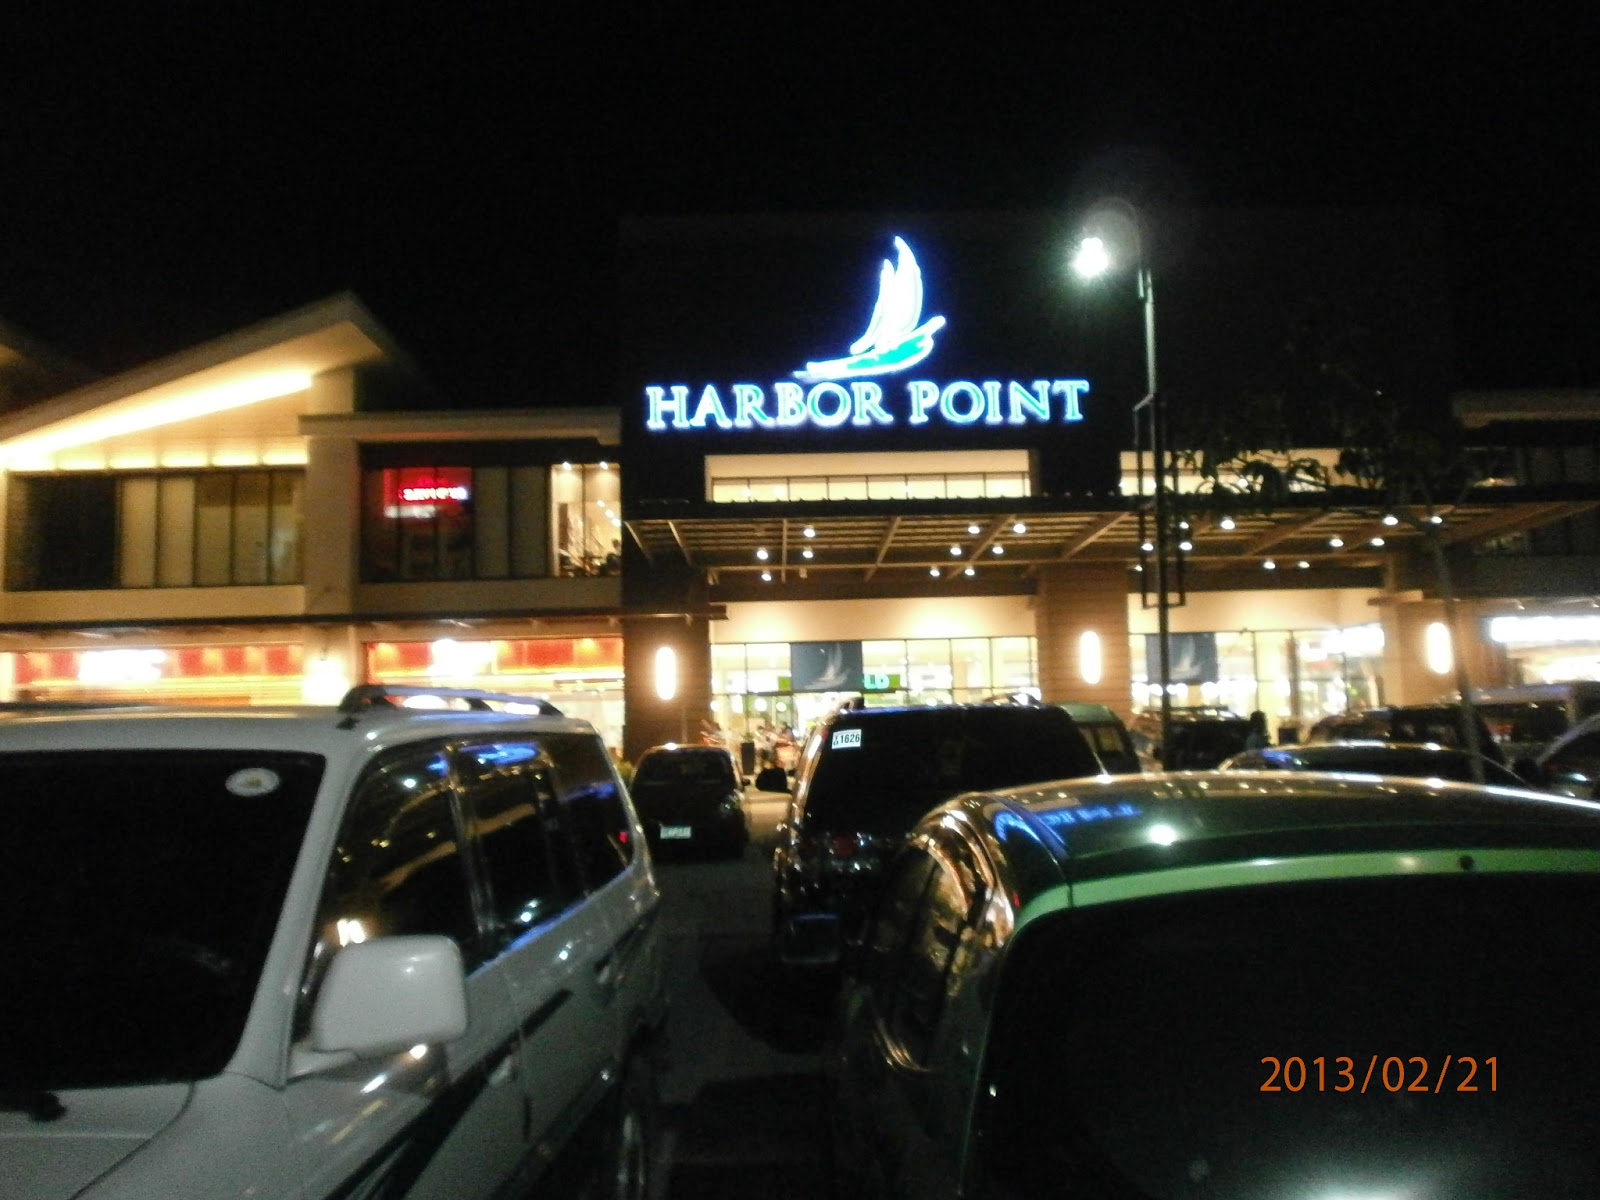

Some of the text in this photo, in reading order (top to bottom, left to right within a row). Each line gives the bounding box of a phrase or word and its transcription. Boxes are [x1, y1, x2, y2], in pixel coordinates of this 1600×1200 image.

[645, 379, 1090, 430] HARBOR POINT
[840, 733, 861, 744] 1626
